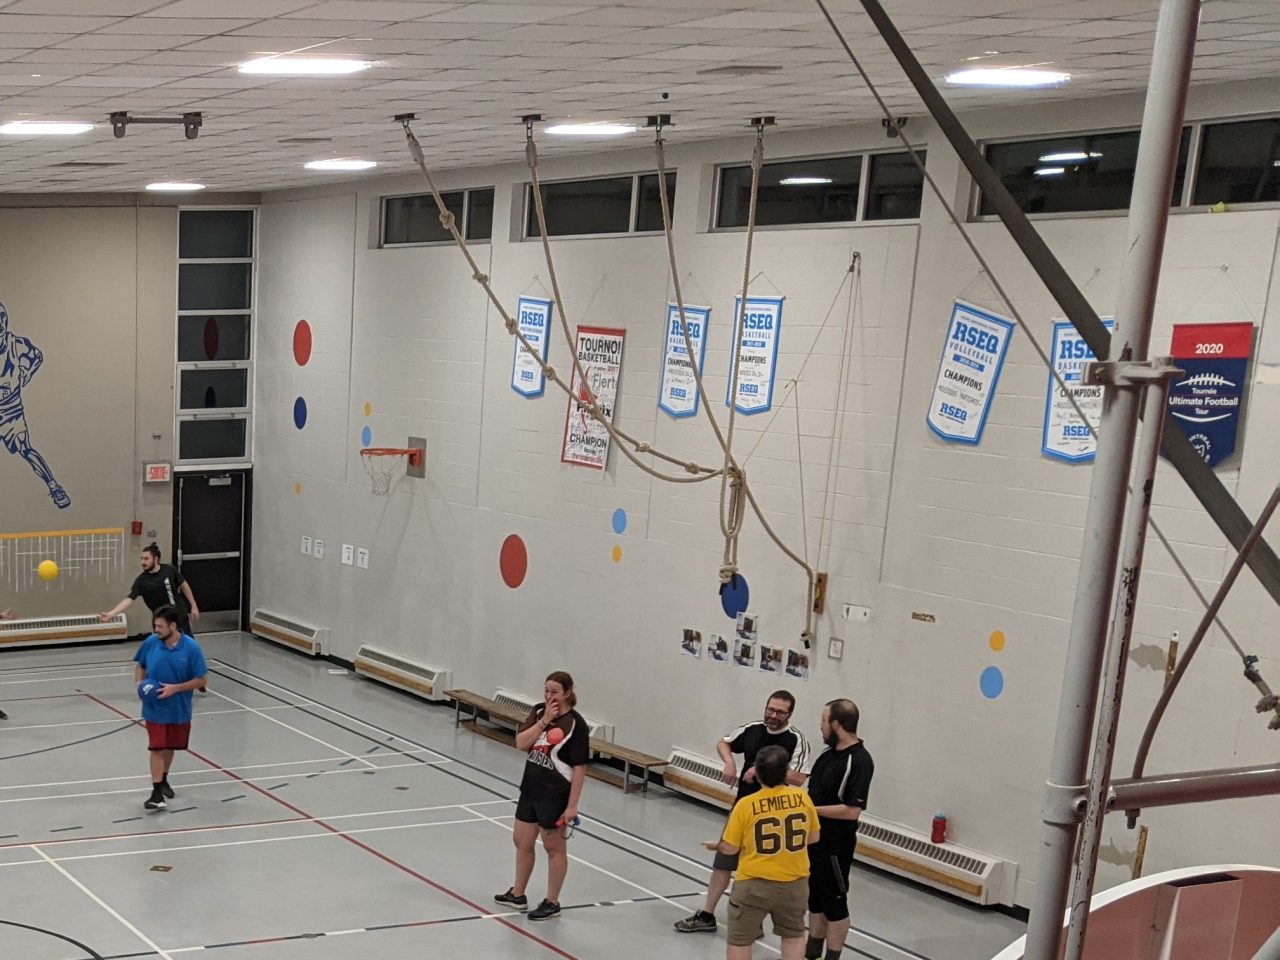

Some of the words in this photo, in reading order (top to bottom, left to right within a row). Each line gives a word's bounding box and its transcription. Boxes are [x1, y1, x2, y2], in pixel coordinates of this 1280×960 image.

[521, 310, 544, 327] RSEQ
[743, 331, 771, 340] SKETBALL
[952, 321, 1000, 354] RSEQ
[580, 337, 621, 355] TOURNOI
[949, 342, 993, 365] VOLLEYBALL
[1059, 339, 1096, 359] RSE
[1195, 343, 1224, 354] 2020
[578, 352, 619, 365] BASKETBALL
[739, 383, 759, 394] RSEQ
[944, 369, 983, 392] CHAMPIONS
[1169, 396, 1203, 405] Ultimate
[1205, 396, 1239, 406] Football
[940, 402, 968, 421] RSEQ
[1062, 425, 1091, 437] RSEQ
[570, 433, 608, 449] CHAMPION
[751, 793, 806, 816] LEMIEUX
[754, 812, 808, 855] 66
